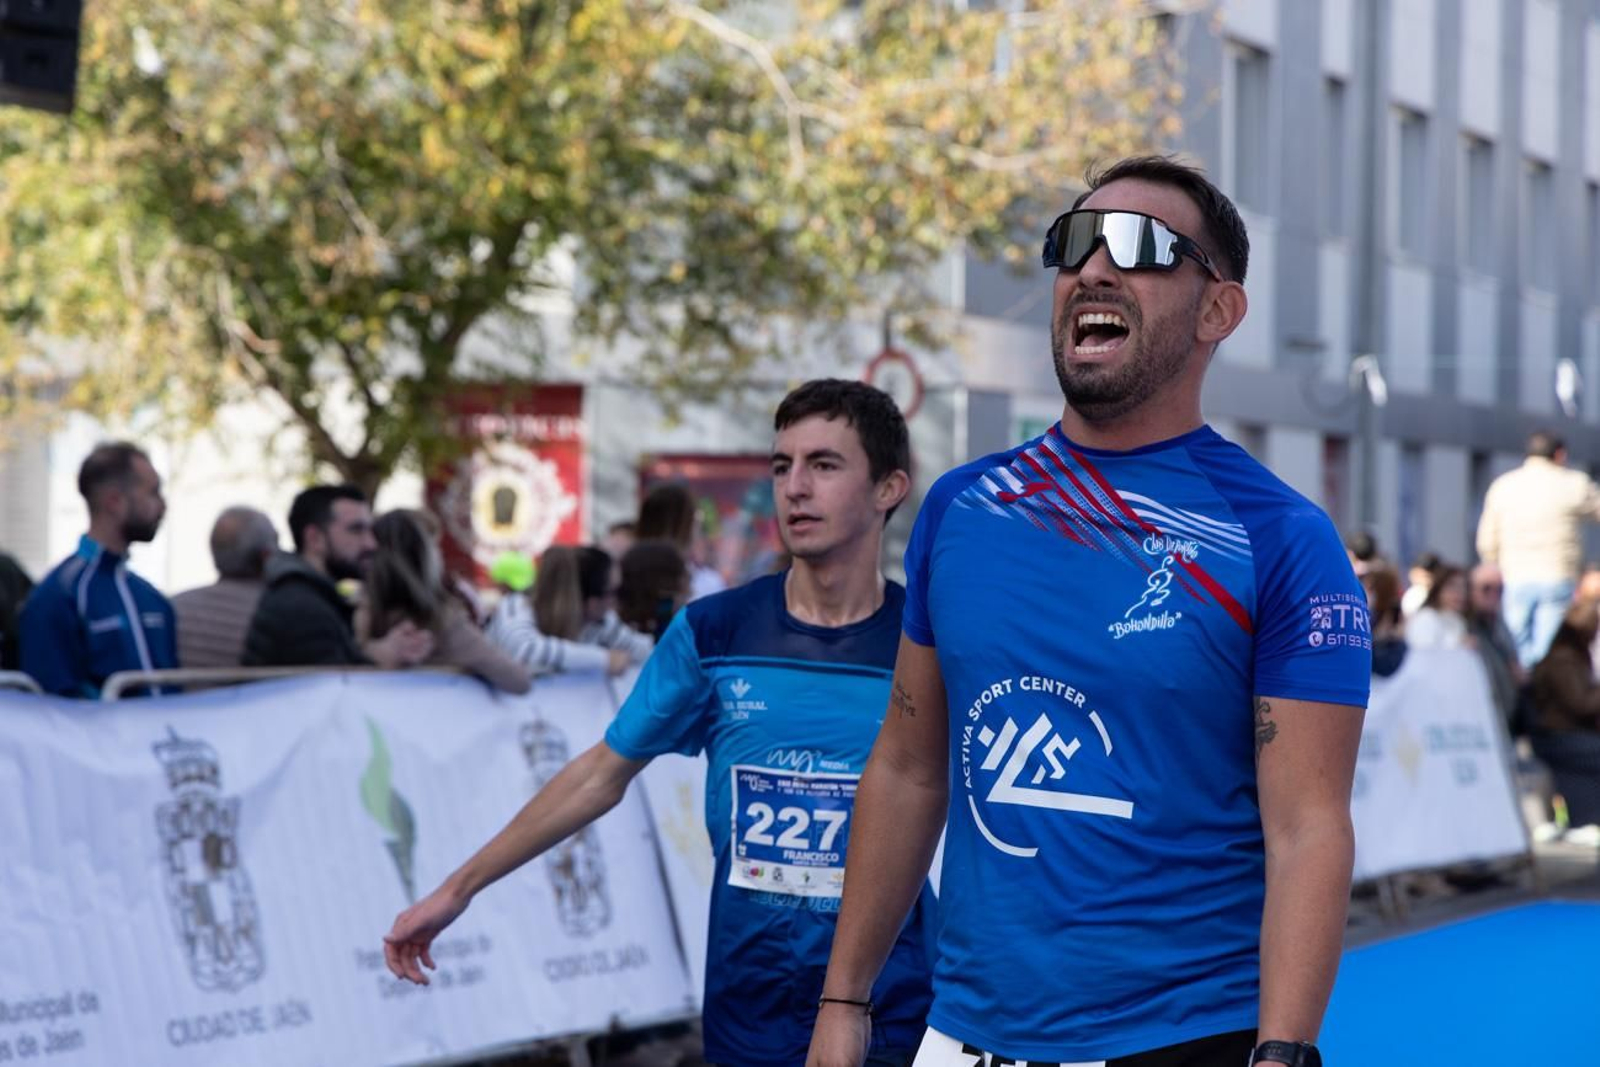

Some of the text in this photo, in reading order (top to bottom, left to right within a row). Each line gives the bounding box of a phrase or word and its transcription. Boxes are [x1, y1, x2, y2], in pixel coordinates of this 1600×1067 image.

[962, 676, 1086, 789] ACTIVA SPORT CENTER
[783, 849, 839, 862] FRANCISCO
